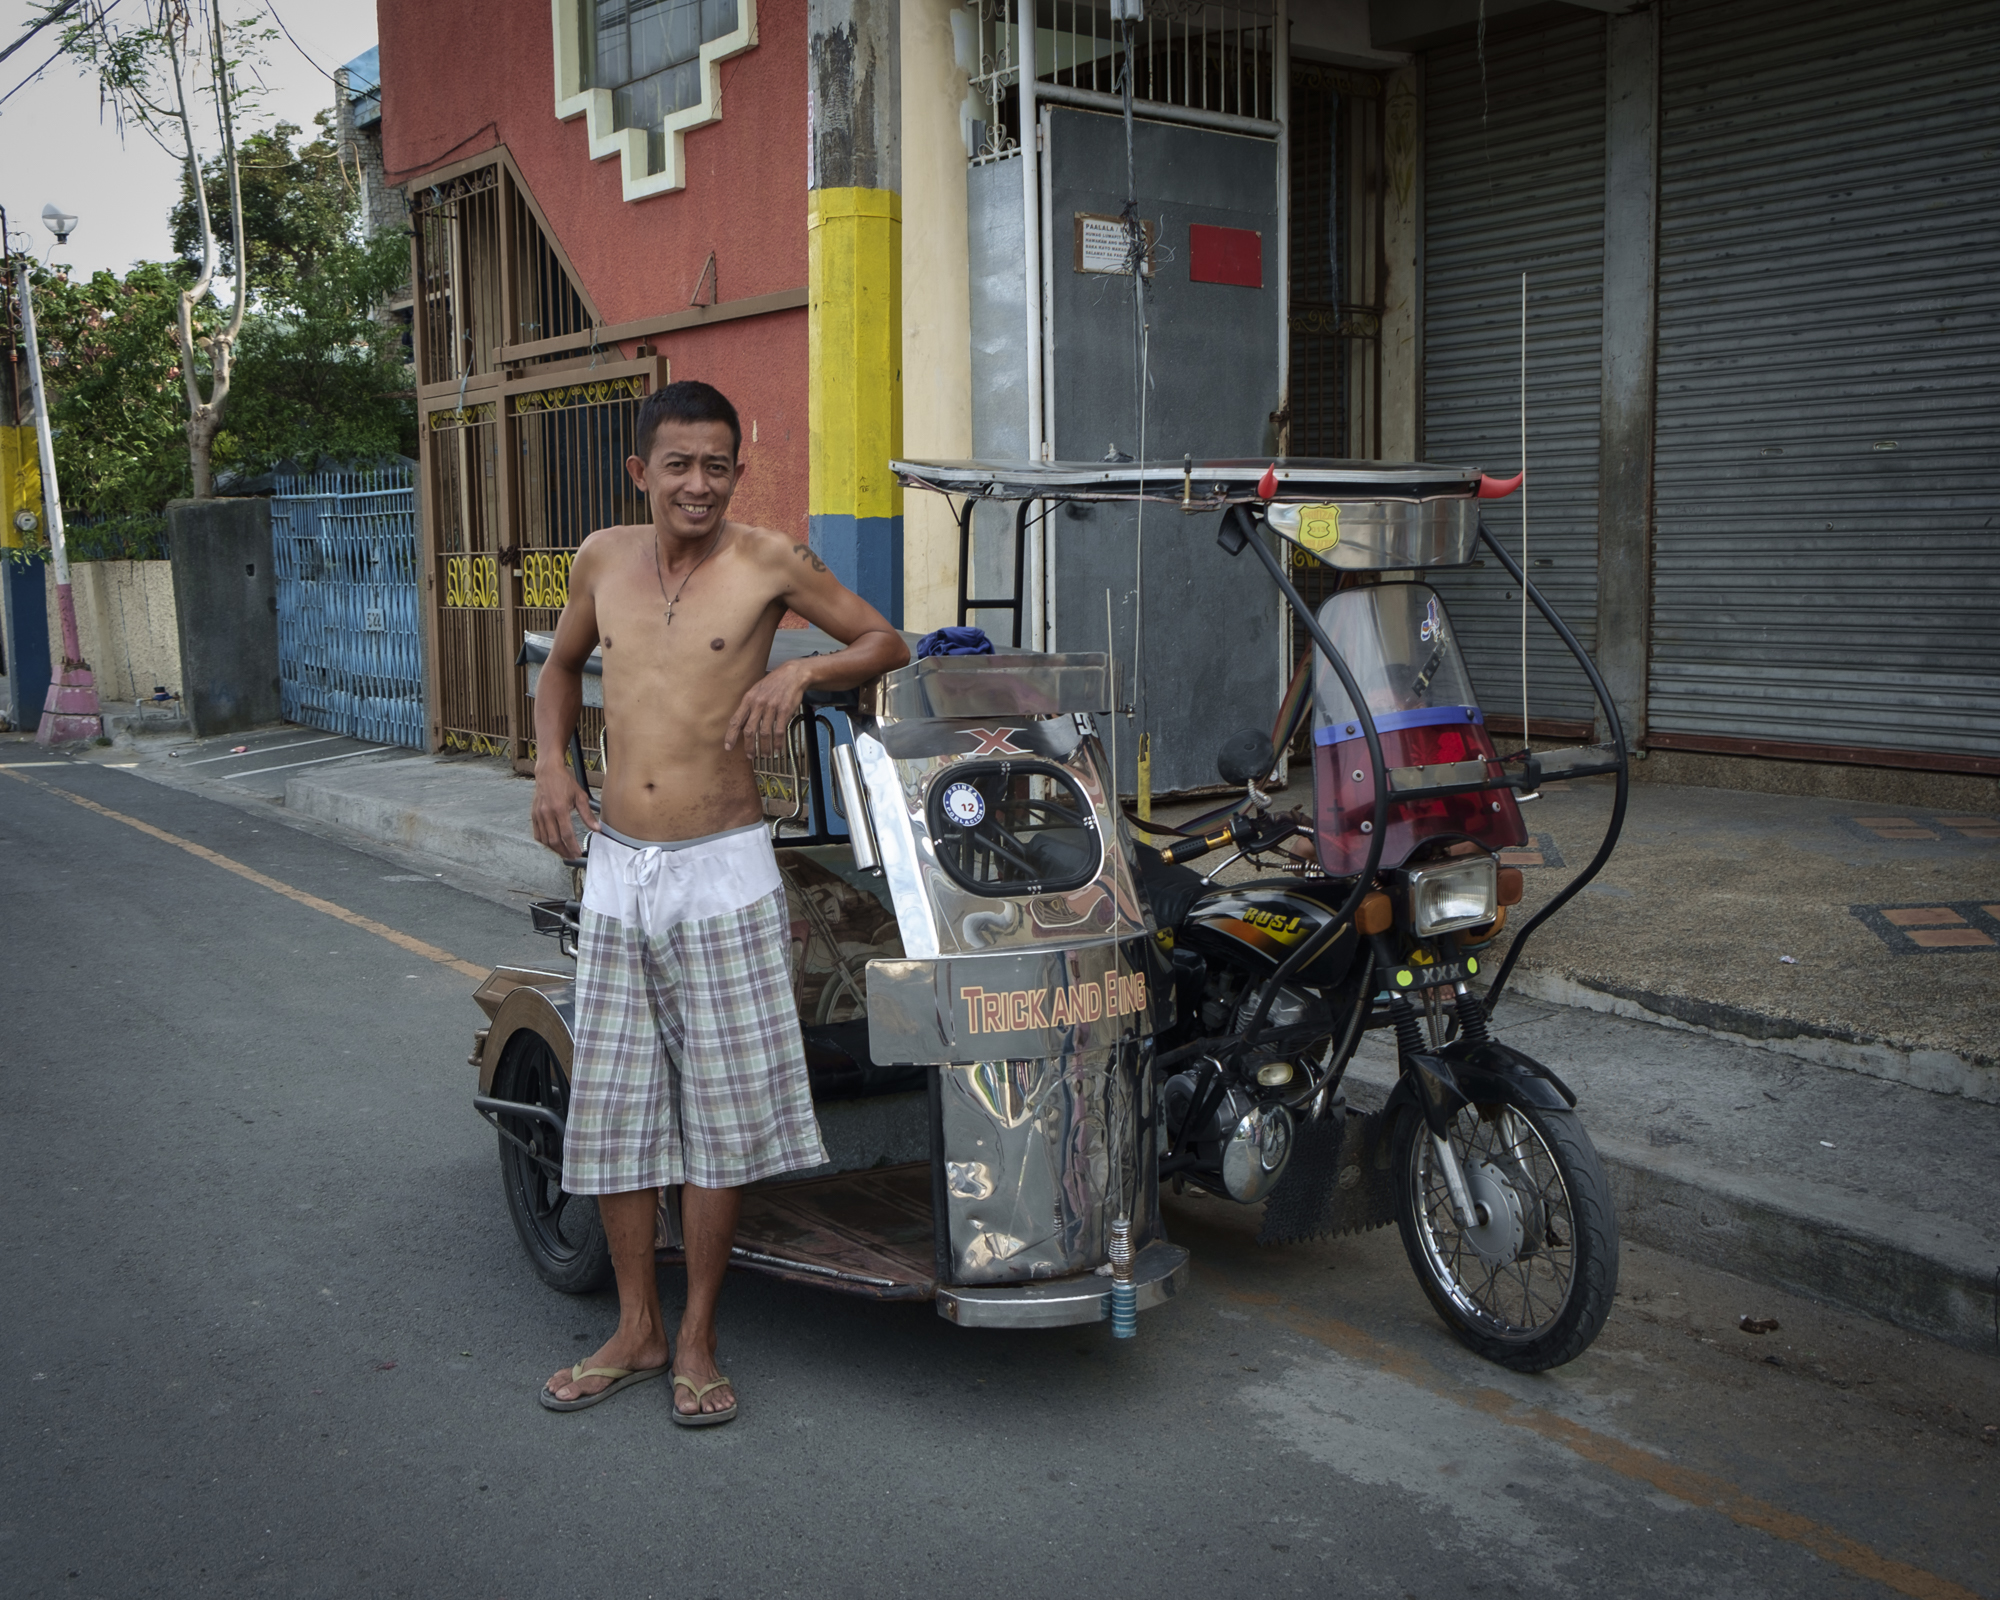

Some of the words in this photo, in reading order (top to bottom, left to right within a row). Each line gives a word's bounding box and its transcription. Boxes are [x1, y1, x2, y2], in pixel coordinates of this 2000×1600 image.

[1086, 223, 1114, 232] PAALALA
[947, 784, 978, 798] PRINZA
[946, 806, 984, 825] POBLACION
[961, 802, 975, 813] 12
[1242, 907, 1301, 934] RUSI
[960, 986, 1050, 1034] TRICK
[1051, 982, 1101, 1028] AND
